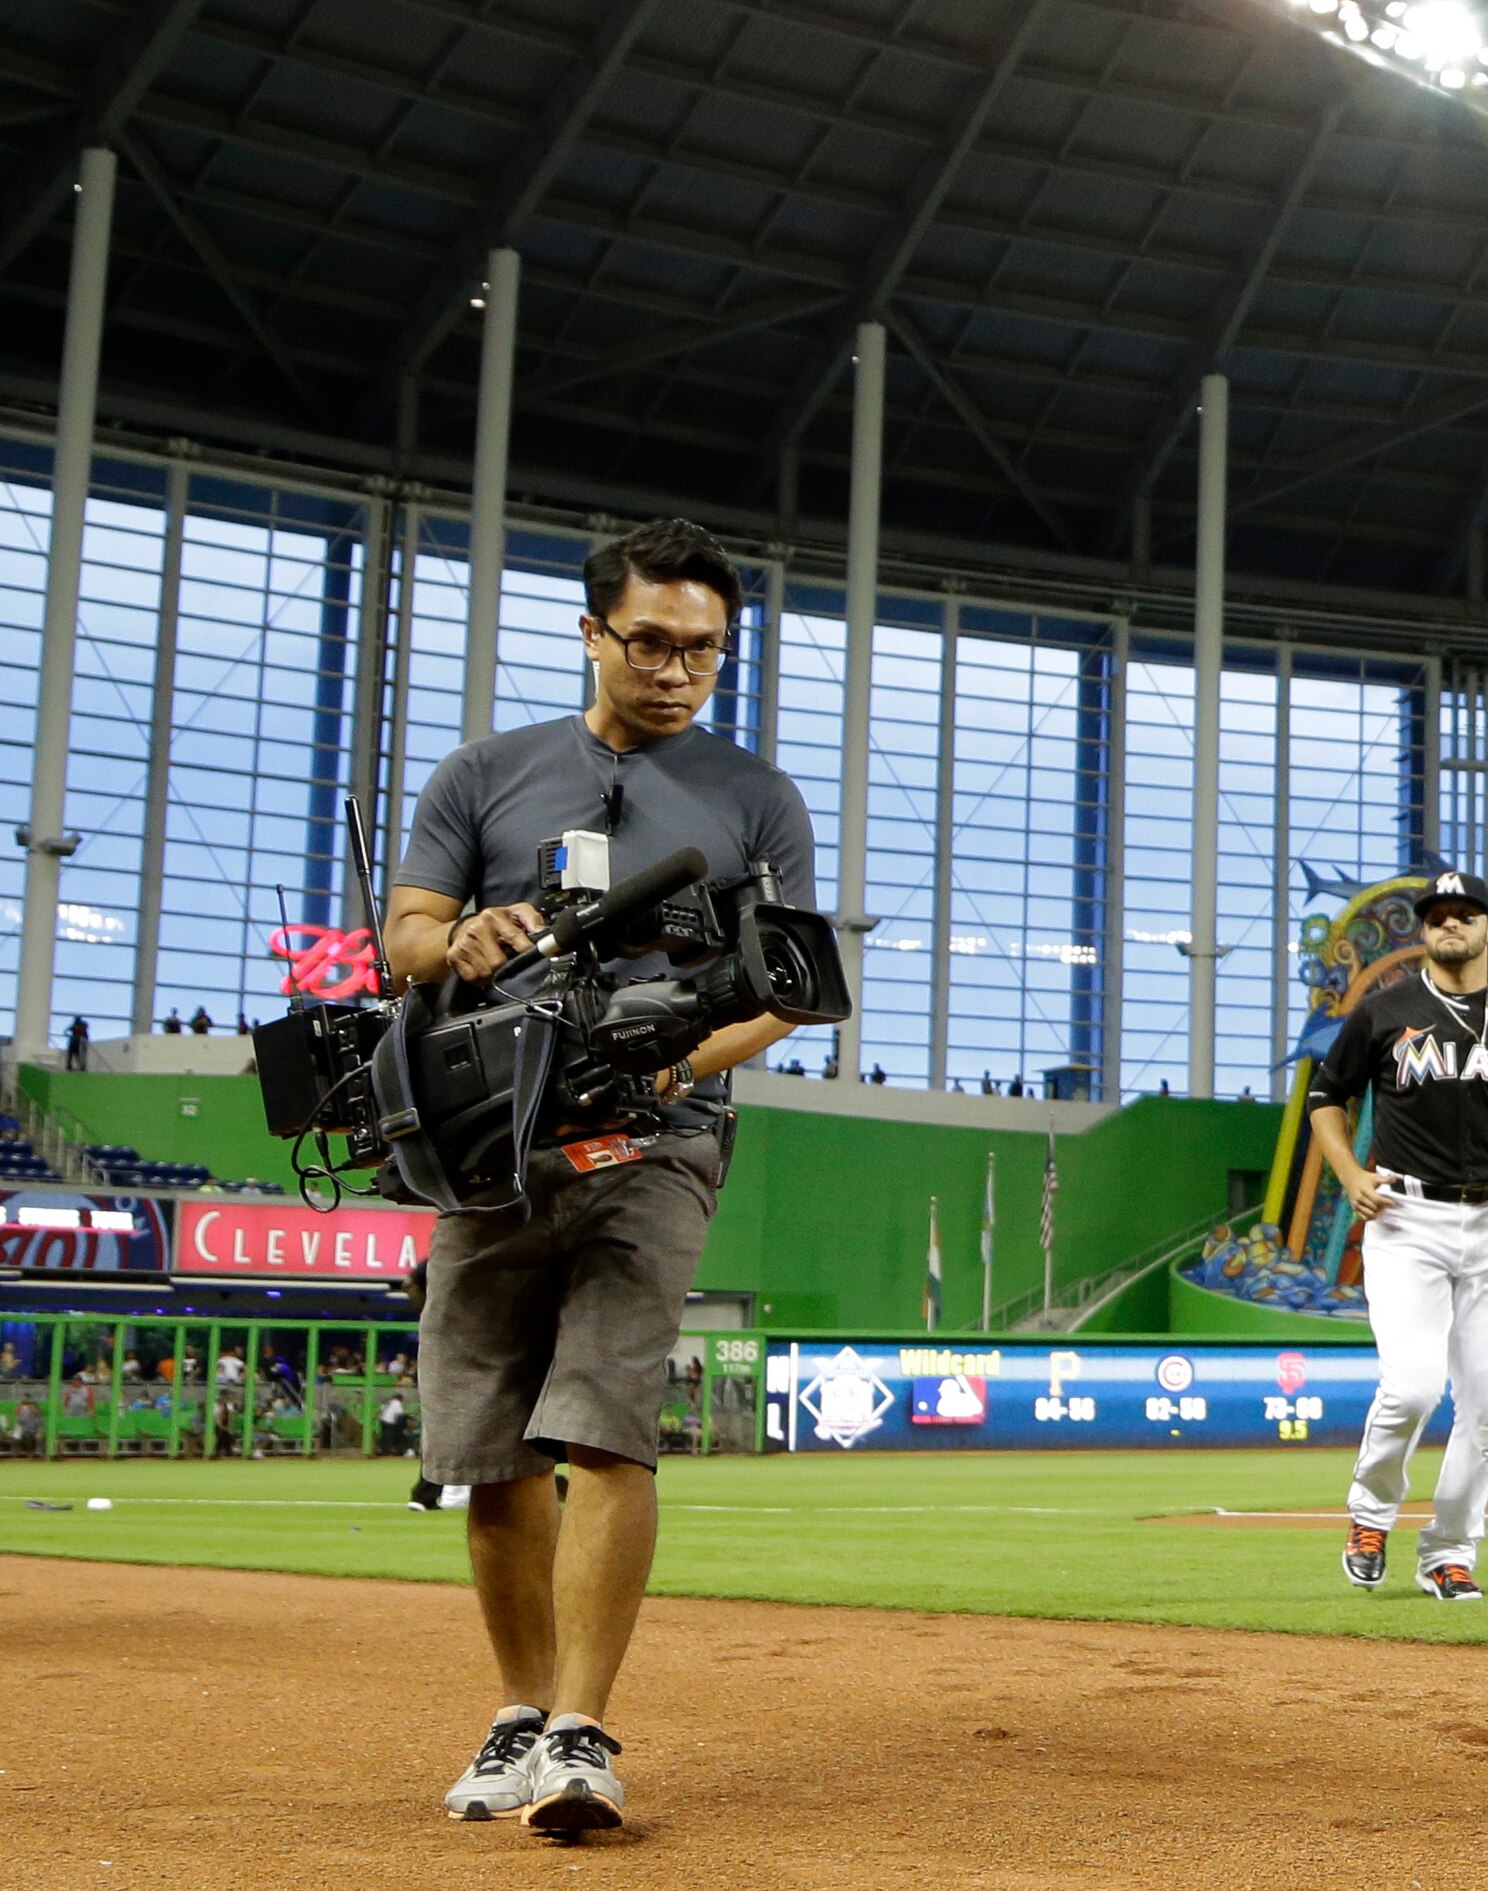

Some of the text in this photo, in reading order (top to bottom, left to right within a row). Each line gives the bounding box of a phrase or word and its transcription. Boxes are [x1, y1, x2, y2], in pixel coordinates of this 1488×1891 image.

[611, 1023, 656, 1041] FUJINON
[194, 1210, 419, 1268] CLEVELA
[716, 1340, 758, 1361] 386
[899, 1348, 1001, 1376] Wildcard
[1278, 1420, 1308, 1440] 9.5
